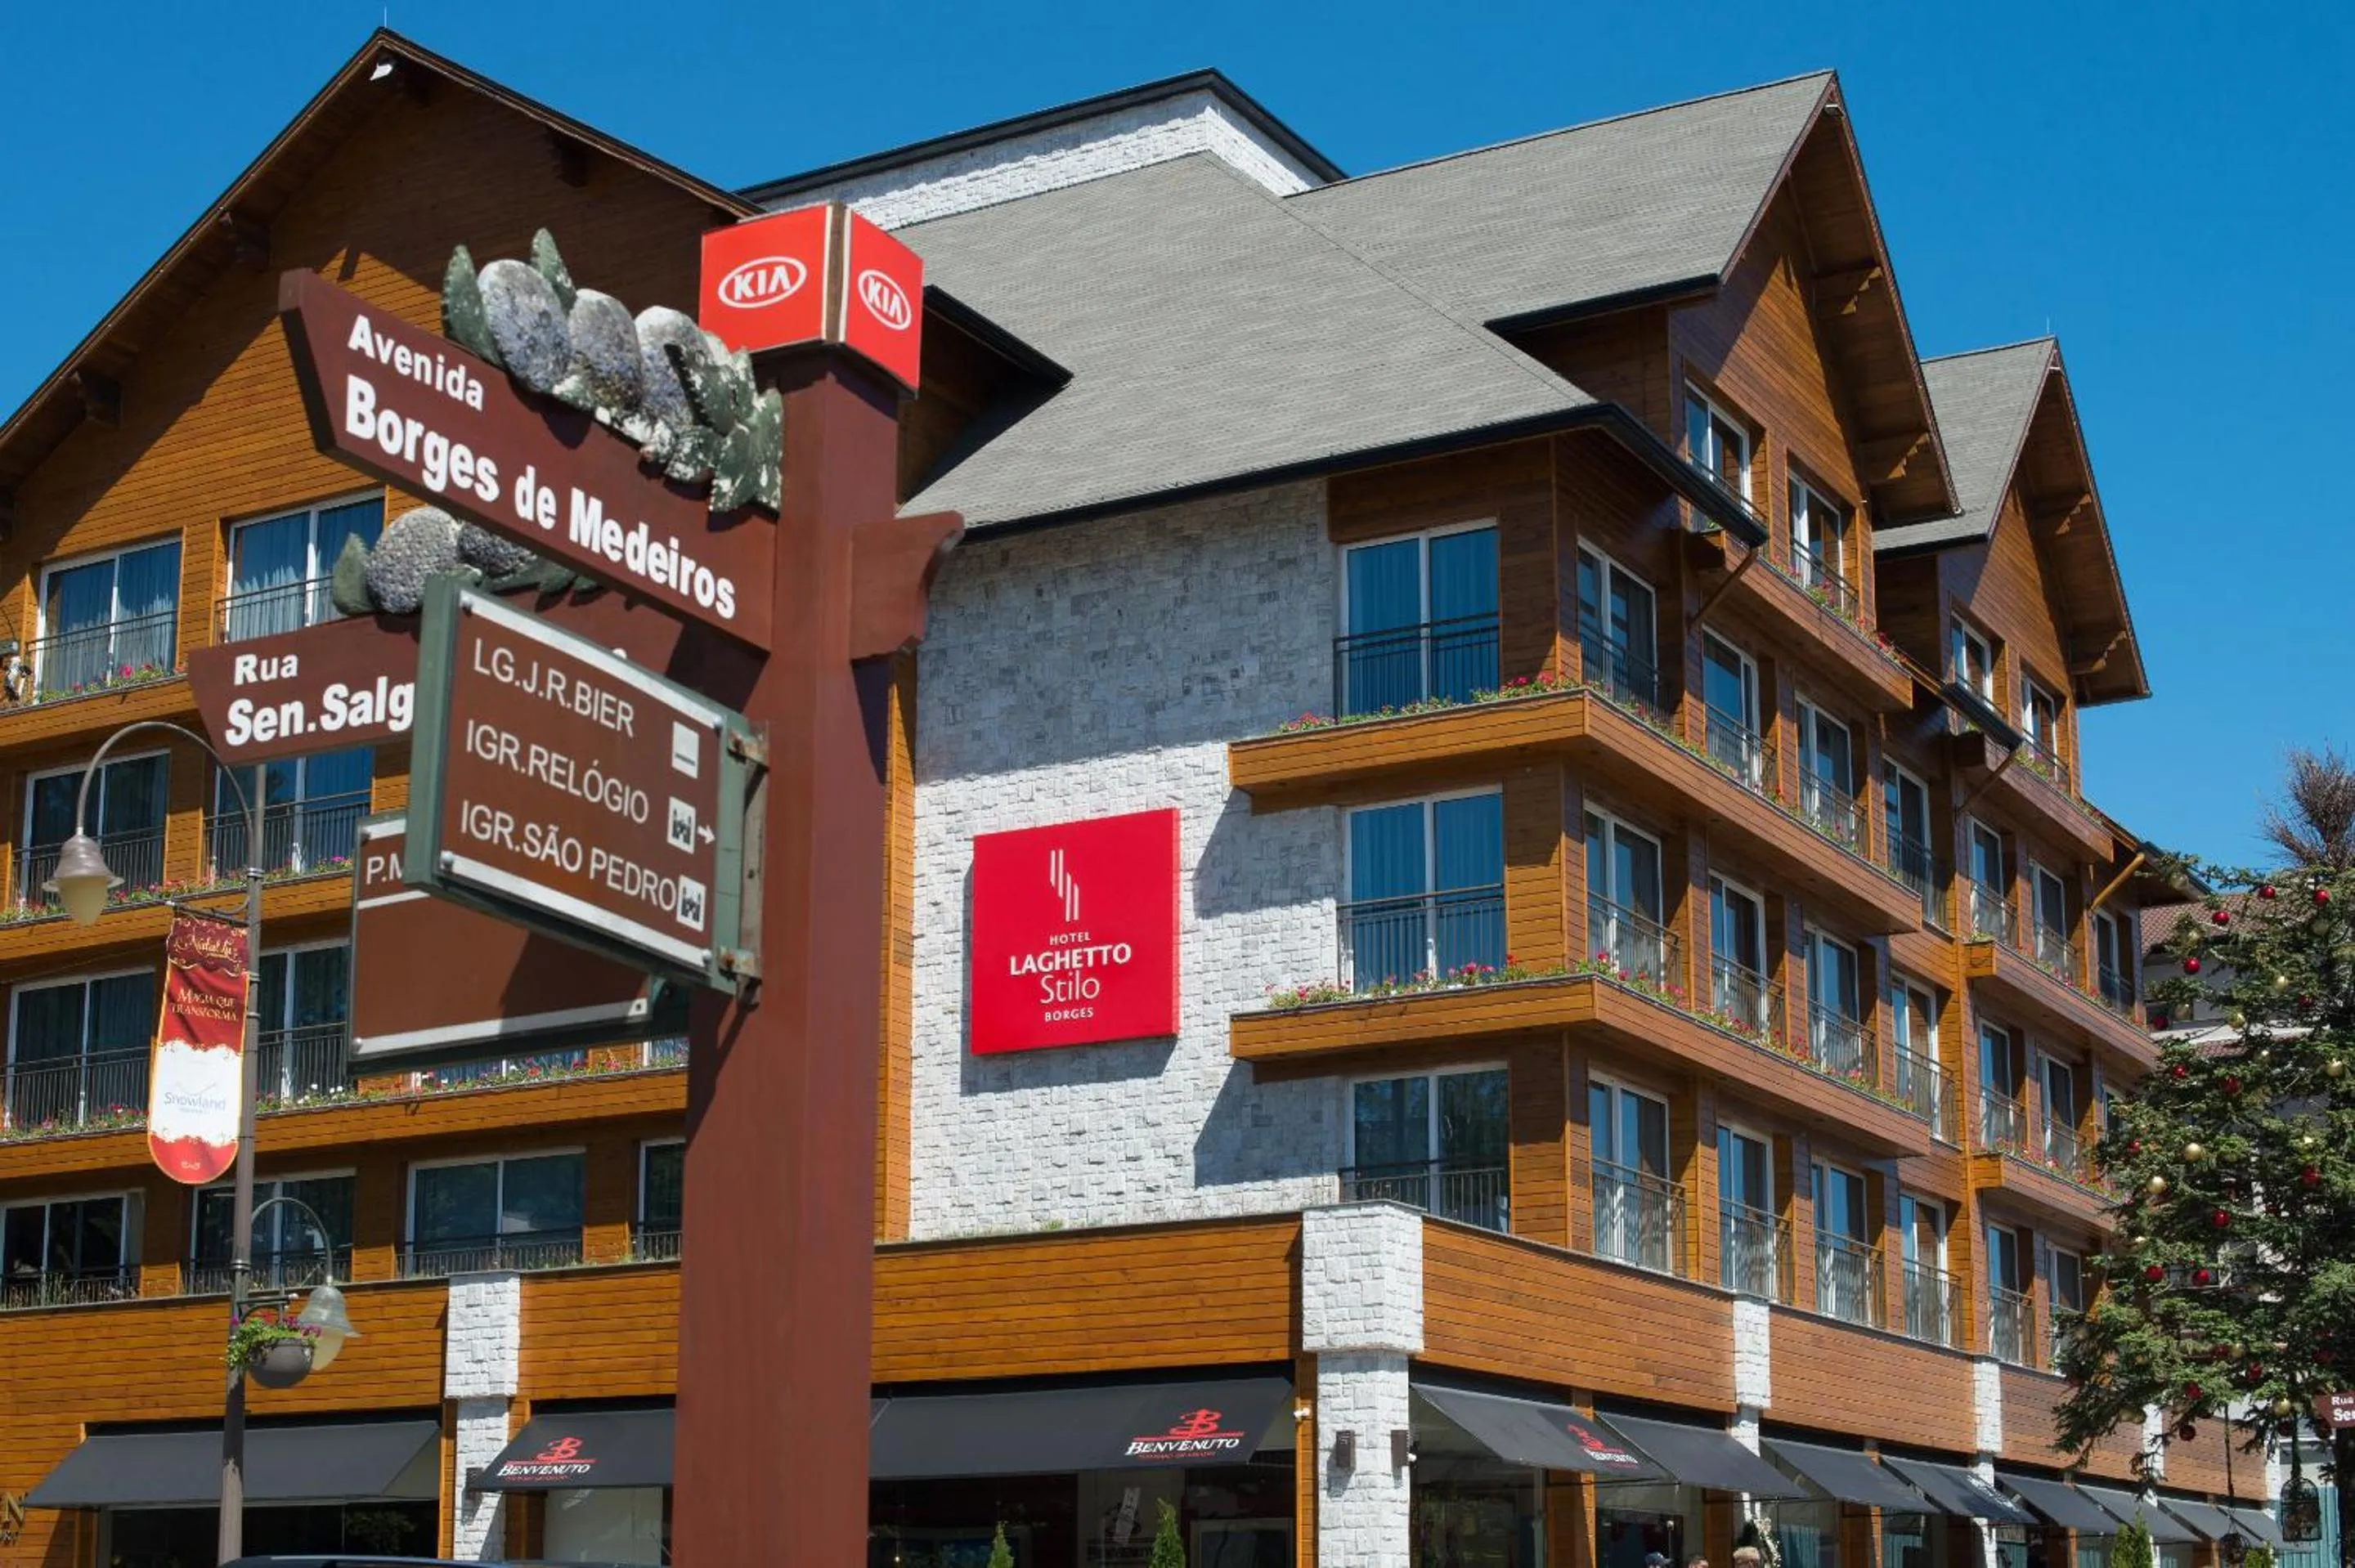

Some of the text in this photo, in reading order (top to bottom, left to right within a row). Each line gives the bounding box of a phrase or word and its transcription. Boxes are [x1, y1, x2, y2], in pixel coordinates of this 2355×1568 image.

[733, 265, 792, 301] KIA
[867, 276, 904, 324] KIA
[348, 314, 483, 411] Avenida
[345, 374, 735, 620] Borges de Medeiros
[234, 653, 298, 685] Rua
[473, 638, 635, 738] LG.J.R.BIER
[466, 719, 649, 823] IGR.RELÓGIO
[460, 800, 677, 912] IGR.SÃO PEDRO
[1049, 932, 1092, 946] HOTEL
[1010, 943, 1132, 976] LAGHETTO
[1040, 970, 1100, 1005] Stilo
[1044, 1006, 1094, 1022] BORGES
[164, 1091, 226, 1112] Snowland
[2331, 1396, 2354, 1405] Rua
[1124, 1438, 1240, 1455] BENVENUTO
[497, 1463, 590, 1476] BENVENUTO
